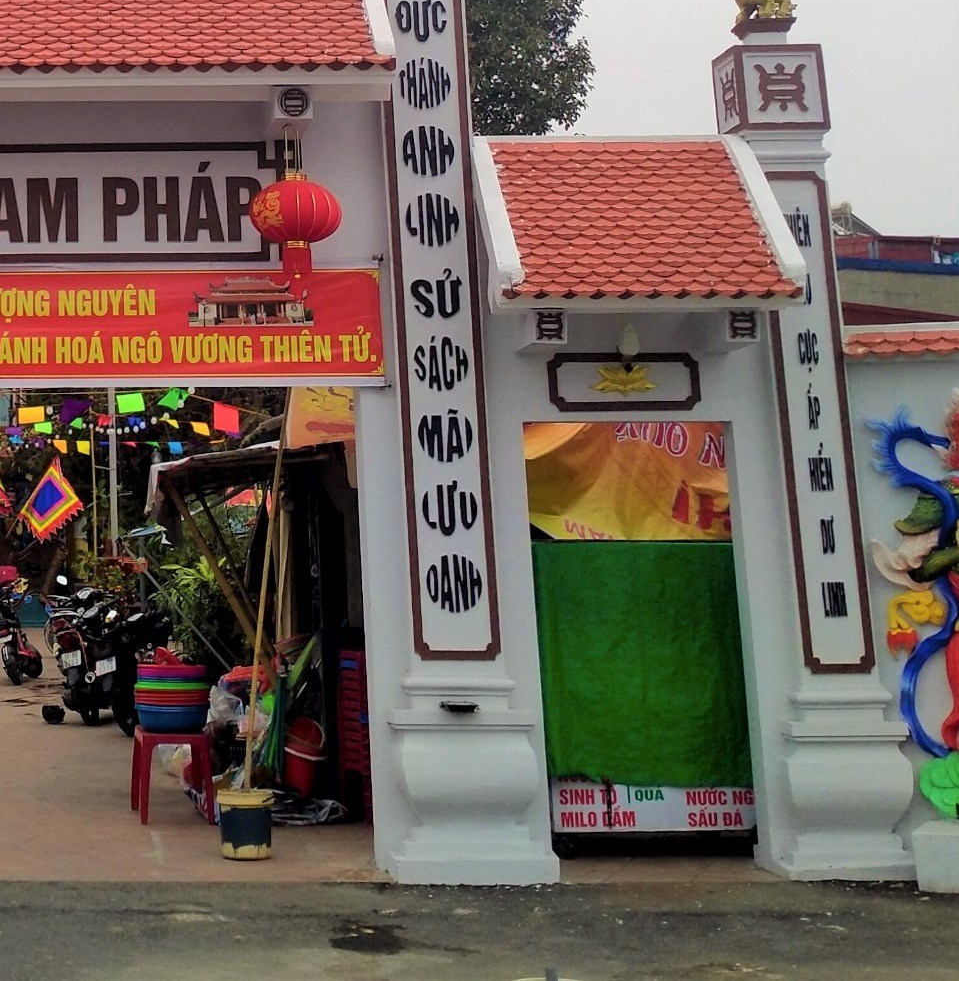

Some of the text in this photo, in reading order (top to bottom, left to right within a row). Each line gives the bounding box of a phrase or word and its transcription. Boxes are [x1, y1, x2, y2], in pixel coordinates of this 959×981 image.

[398, 57, 451, 110] THÁNH
[402, 125, 455, 177] ANH
[102, 161, 262, 242] PHÁP
[405, 192, 460, 247] LINH
[58, 283, 156, 317] NGUYÊN
[410, 267, 463, 319] SỬ
[55, 330, 105, 365] HOÁ
[112, 330, 163, 364] NGÔ
[169, 332, 253, 364] VƯƠNG
[259, 329, 332, 363] THIÊN
[338, 325, 377, 363] TỬ.
[413, 335, 469, 392] SÁCH
[417, 408, 473, 463] MÃI
[421, 480, 478, 537] LƯU
[821, 581, 849, 618] LINH
[559, 788, 595, 806] SINH
[560, 811, 598, 828] MILO
[685, 786, 728, 806] NƯỚC
[687, 807, 744, 827] SẤU ĐÁ
